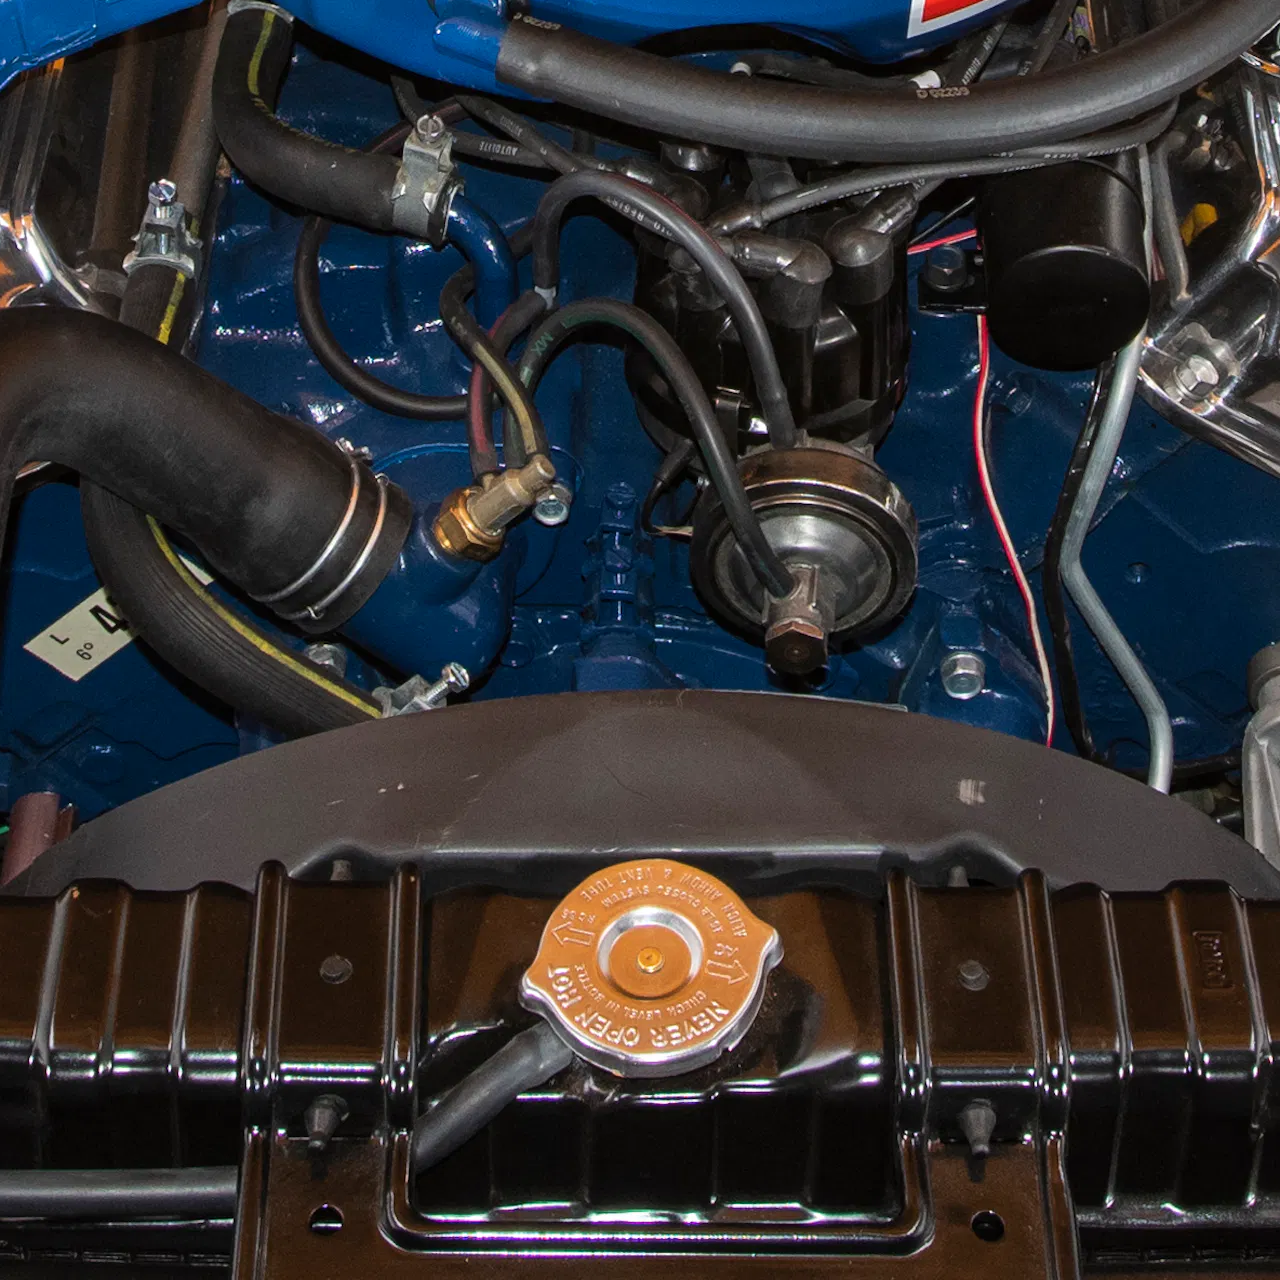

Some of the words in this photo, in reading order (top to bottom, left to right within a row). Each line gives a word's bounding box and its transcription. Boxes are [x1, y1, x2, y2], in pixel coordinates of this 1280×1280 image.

[48, 627, 70, 648] L
[547, 964, 580, 1008] HOT
[666, 989, 706, 1014] CHECK
[574, 1006, 639, 1046] OPEN
[624, 1006, 660, 1020] LEVEL
[650, 1000, 729, 1047] NEVER
